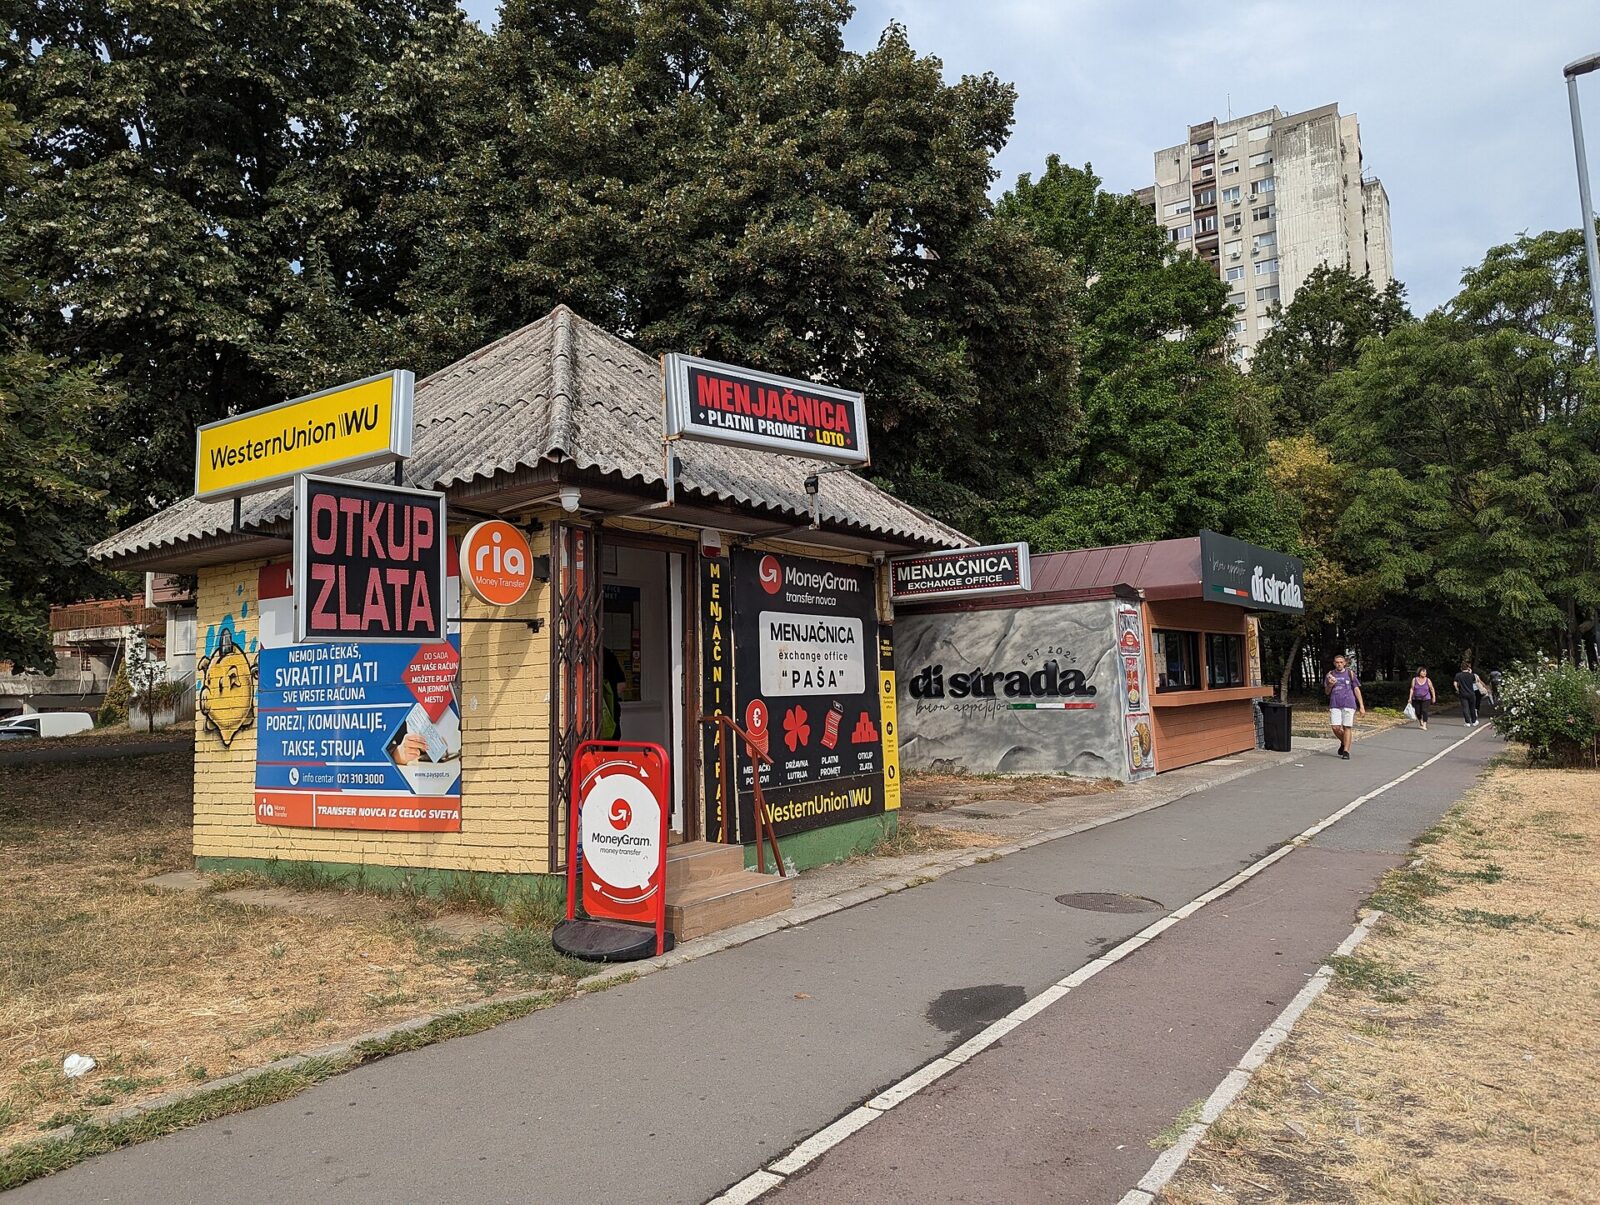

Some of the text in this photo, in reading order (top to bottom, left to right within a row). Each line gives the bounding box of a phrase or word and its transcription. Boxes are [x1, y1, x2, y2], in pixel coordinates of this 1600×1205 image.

[696, 373, 851, 434] MENJAČNICA
[707, 409, 845, 448] PLATNI PROMET LOTO
[210, 420, 336, 470] WesternUnion
[310, 493, 435, 562] OTKUP
[475, 531, 526, 576] ria
[897, 555, 1013, 582] MENJAČNICA
[476, 575, 526, 589] Money Transfer
[907, 574, 1003, 590] EXCHANGE OFFICE
[1251, 565, 1265, 603] di
[310, 562, 436, 632] ZLATA
[785, 591, 837, 606] transfer novca
[770, 621, 855, 644] MENJAČNICA
[288, 649, 315, 664] NEMOJ
[316, 648, 328, 661] DA
[423, 651, 449, 660] OD SADA
[778, 650, 848, 663] exchange office
[1021, 645, 1078, 667] EST 2024
[275, 661, 378, 688] SVRATI I PLATI
[410, 664, 421, 672] SVE
[421, 662, 437, 671] VAŠE
[411, 675, 435, 684] MOŽETE
[908, 663, 946, 699] di
[282, 686, 366, 703] SVE VRSTE RAČUNA
[417, 684, 449, 694] NA JEDNOM
[424, 695, 444, 704] MESTU
[915, 698, 949, 717] buon
[953, 698, 1006, 720] appetito
[266, 712, 387, 733] POREZI, KOMUNALIJE,
[281, 739, 365, 760] TAKSE, STRUJA
[857, 751, 874, 760] OTKUP
[785, 759, 809, 769] DRŽAVNA
[821, 755, 839, 765] PLATNI
[859, 762, 874, 771] ZLATA
[302, 772, 385, 784] info centar 021 310 3000
[787, 770, 809, 780] LUTRIJA
[820, 766, 842, 776] PROMET
[258, 797, 274, 817] ria
[317, 805, 460, 820] TRANSFER NOVCA IZ CELOG SVETA
[599, 847, 642, 857] money transfer
